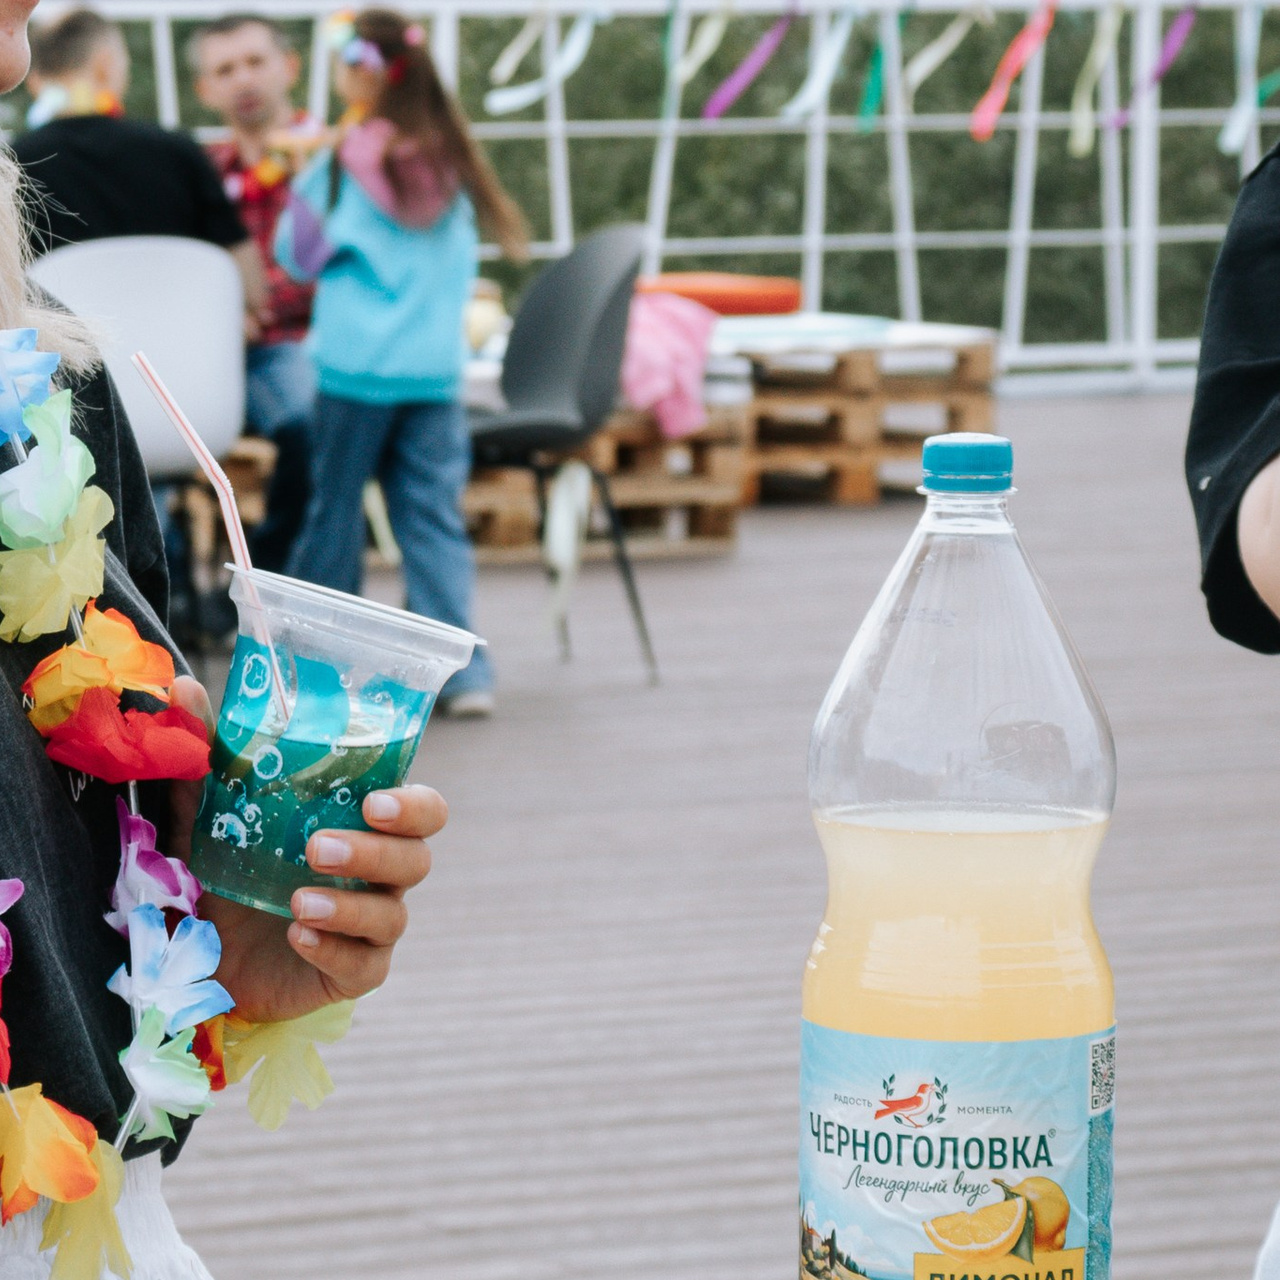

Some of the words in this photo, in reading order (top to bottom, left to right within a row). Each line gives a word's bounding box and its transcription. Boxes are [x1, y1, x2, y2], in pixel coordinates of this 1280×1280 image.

[833, 1093, 873, 1108] РАДОСТЬ
[957, 1105, 1013, 1115] МОМЕНТА
[809, 1111, 1054, 1170] ЧЕРНОГОЛОВКА
[842, 1164, 948, 1203] Легендарный
[953, 1170, 991, 1207] вкус
